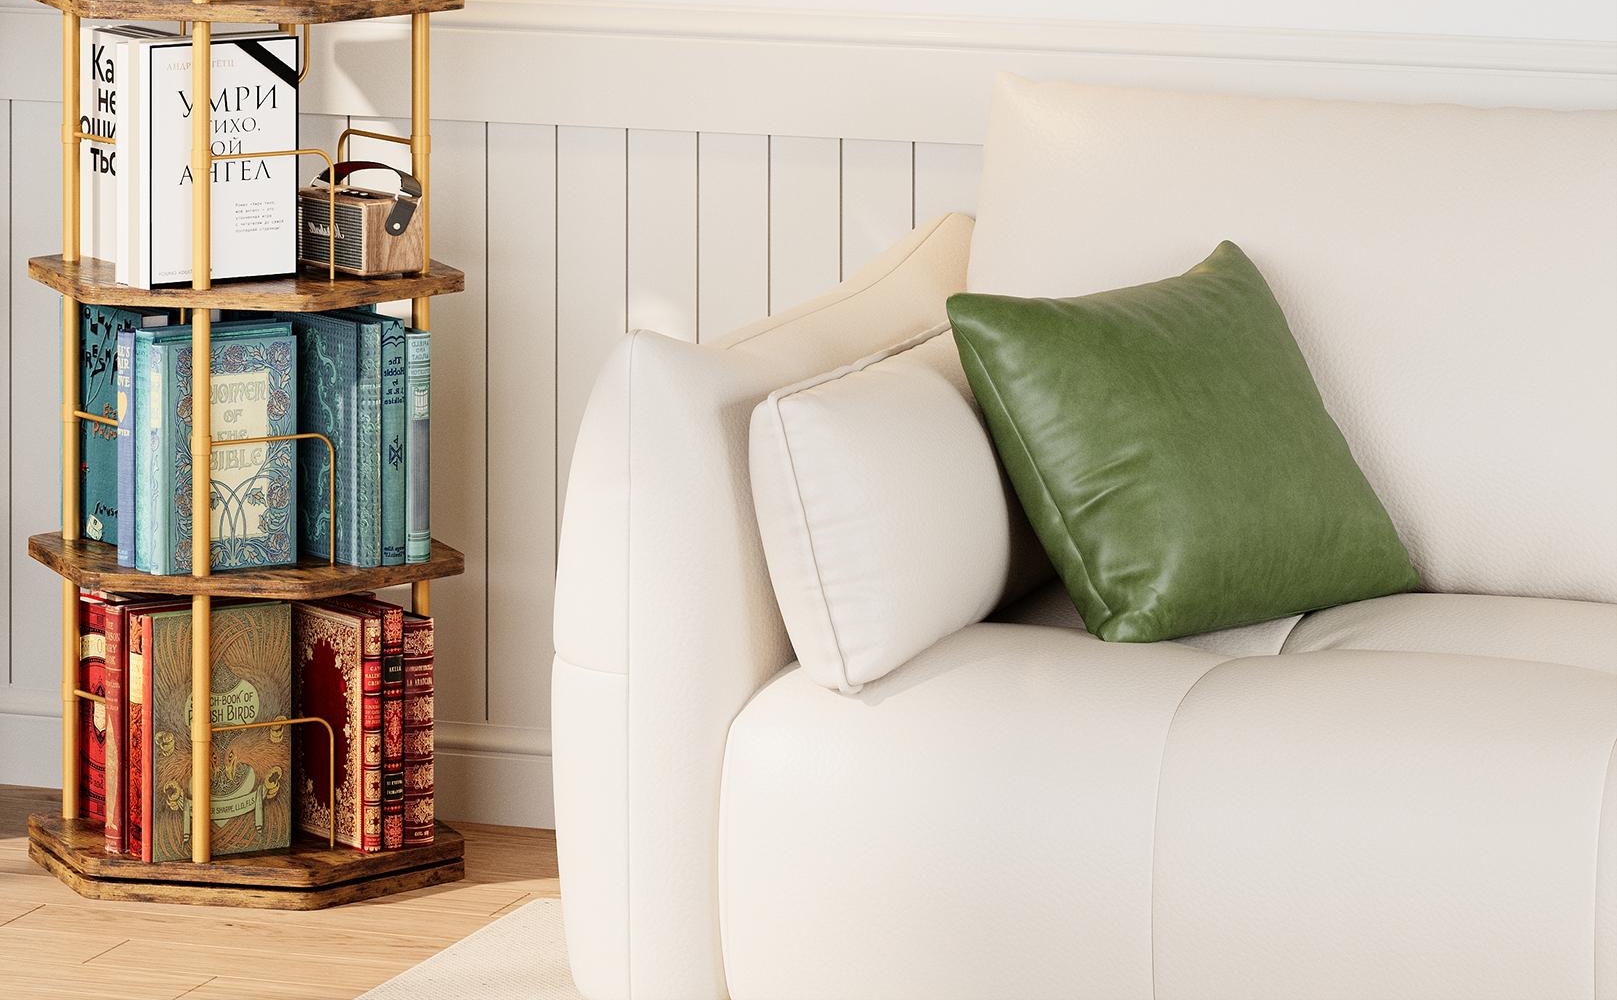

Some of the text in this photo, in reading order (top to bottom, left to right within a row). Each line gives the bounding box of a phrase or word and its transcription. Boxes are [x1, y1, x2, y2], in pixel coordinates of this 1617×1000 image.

[92, 43, 115, 84] Ка
[178, 84, 279, 118] УМРИ
[79, 115, 116, 141] оши
[210, 117, 261, 134] ИХО.
[210, 136, 242, 157] ОЙ
[90, 147, 116, 177] тьс
[179, 160, 271, 185] АНГЕЛ
[224, 408, 244, 423] OF
[210, 447, 264, 472] BIBLE
[244, 691, 254, 703] OF
